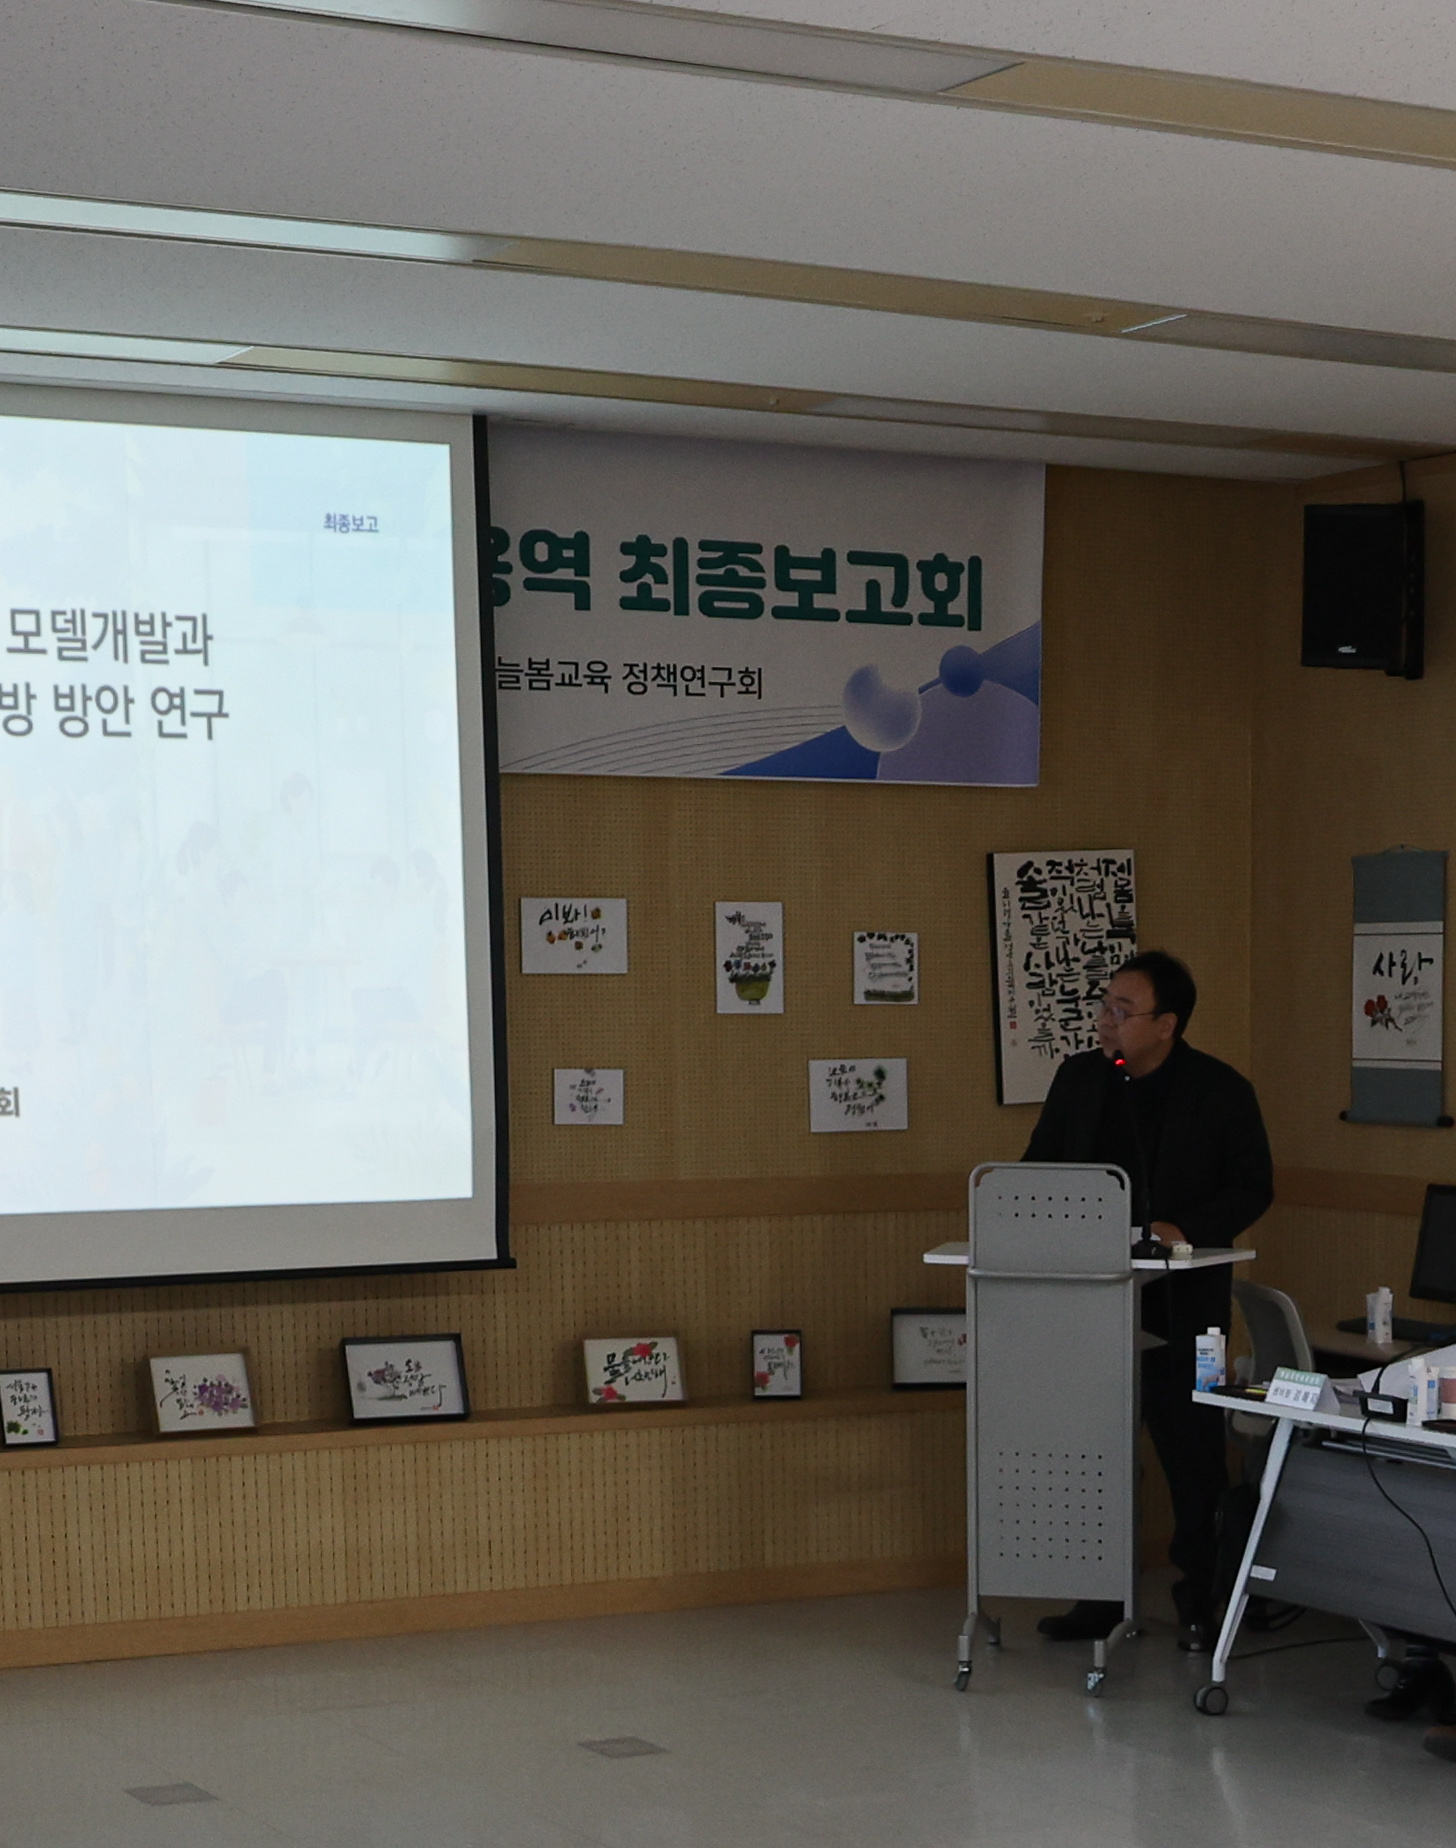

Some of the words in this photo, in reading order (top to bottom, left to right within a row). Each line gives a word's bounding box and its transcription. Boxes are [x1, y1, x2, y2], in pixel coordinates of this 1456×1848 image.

[322, 511, 380, 535] 최종보고
[618, 532, 984, 632] 최종보고회
[5, 604, 215, 669] 모델개발과
[493, 656, 613, 696] 늘봄교육
[621, 661, 764, 701] 정책연구회
[52, 682, 136, 741] 방안
[149, 683, 231, 742] 연구
[1372, 946, 1435, 986] 사랑
